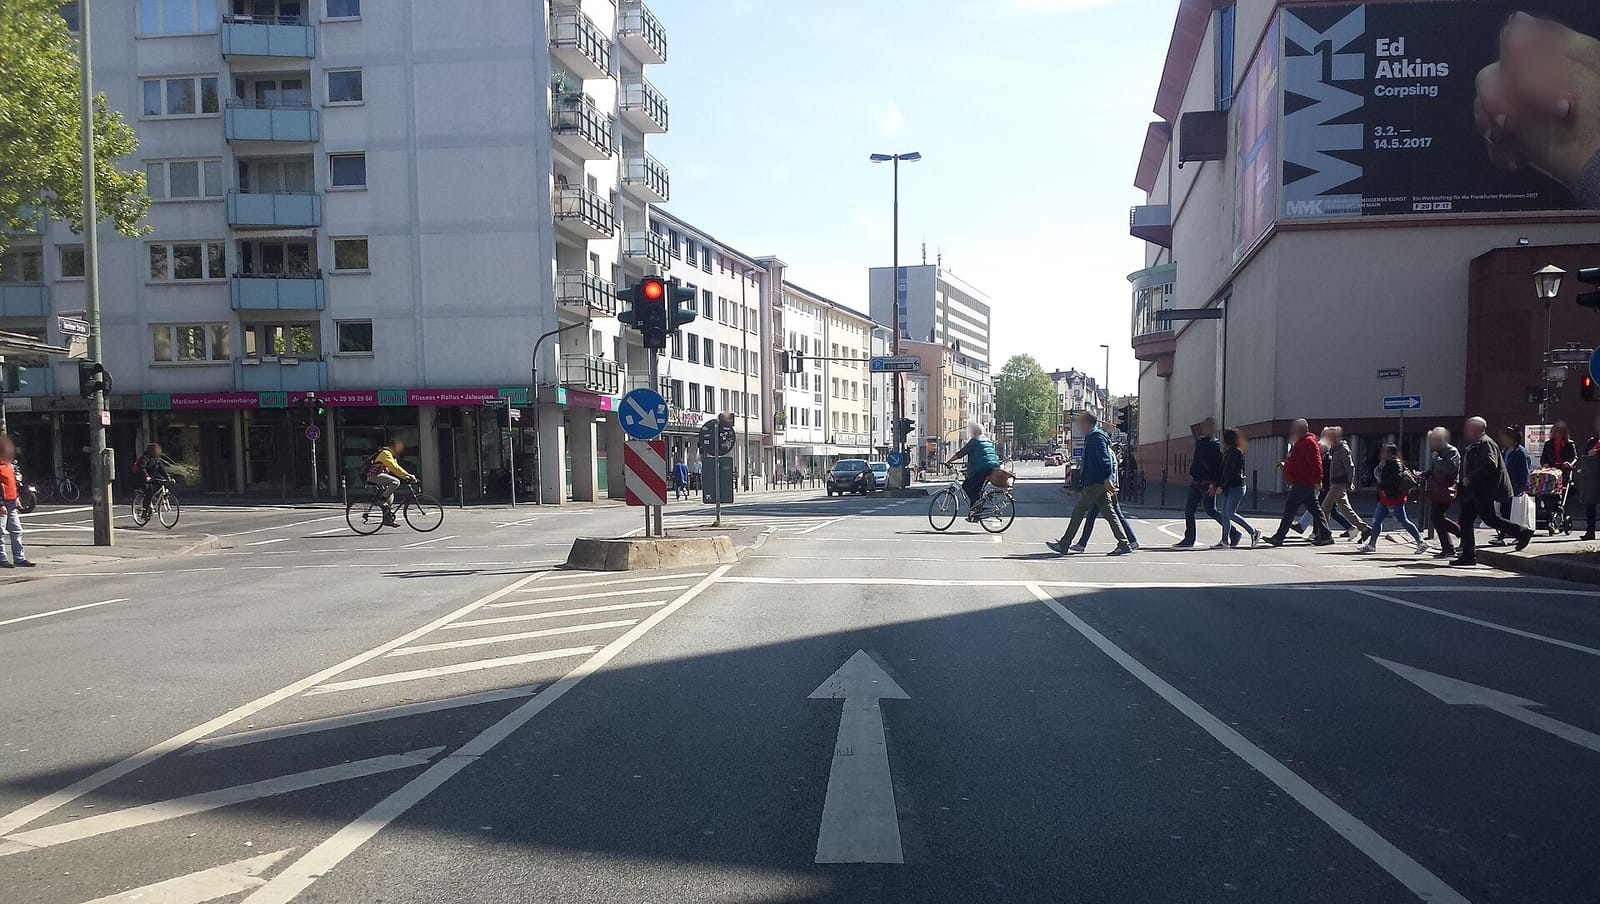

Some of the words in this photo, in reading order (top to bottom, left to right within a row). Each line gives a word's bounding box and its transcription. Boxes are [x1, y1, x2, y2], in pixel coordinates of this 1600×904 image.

[1376, 36, 1405, 56] Ed
[1374, 58, 1449, 79] Atkins
[1374, 84, 1438, 98] Corpsing
[1374, 125, 1398, 137] 3.2.
[1374, 137, 1433, 150] 14.5.2017
